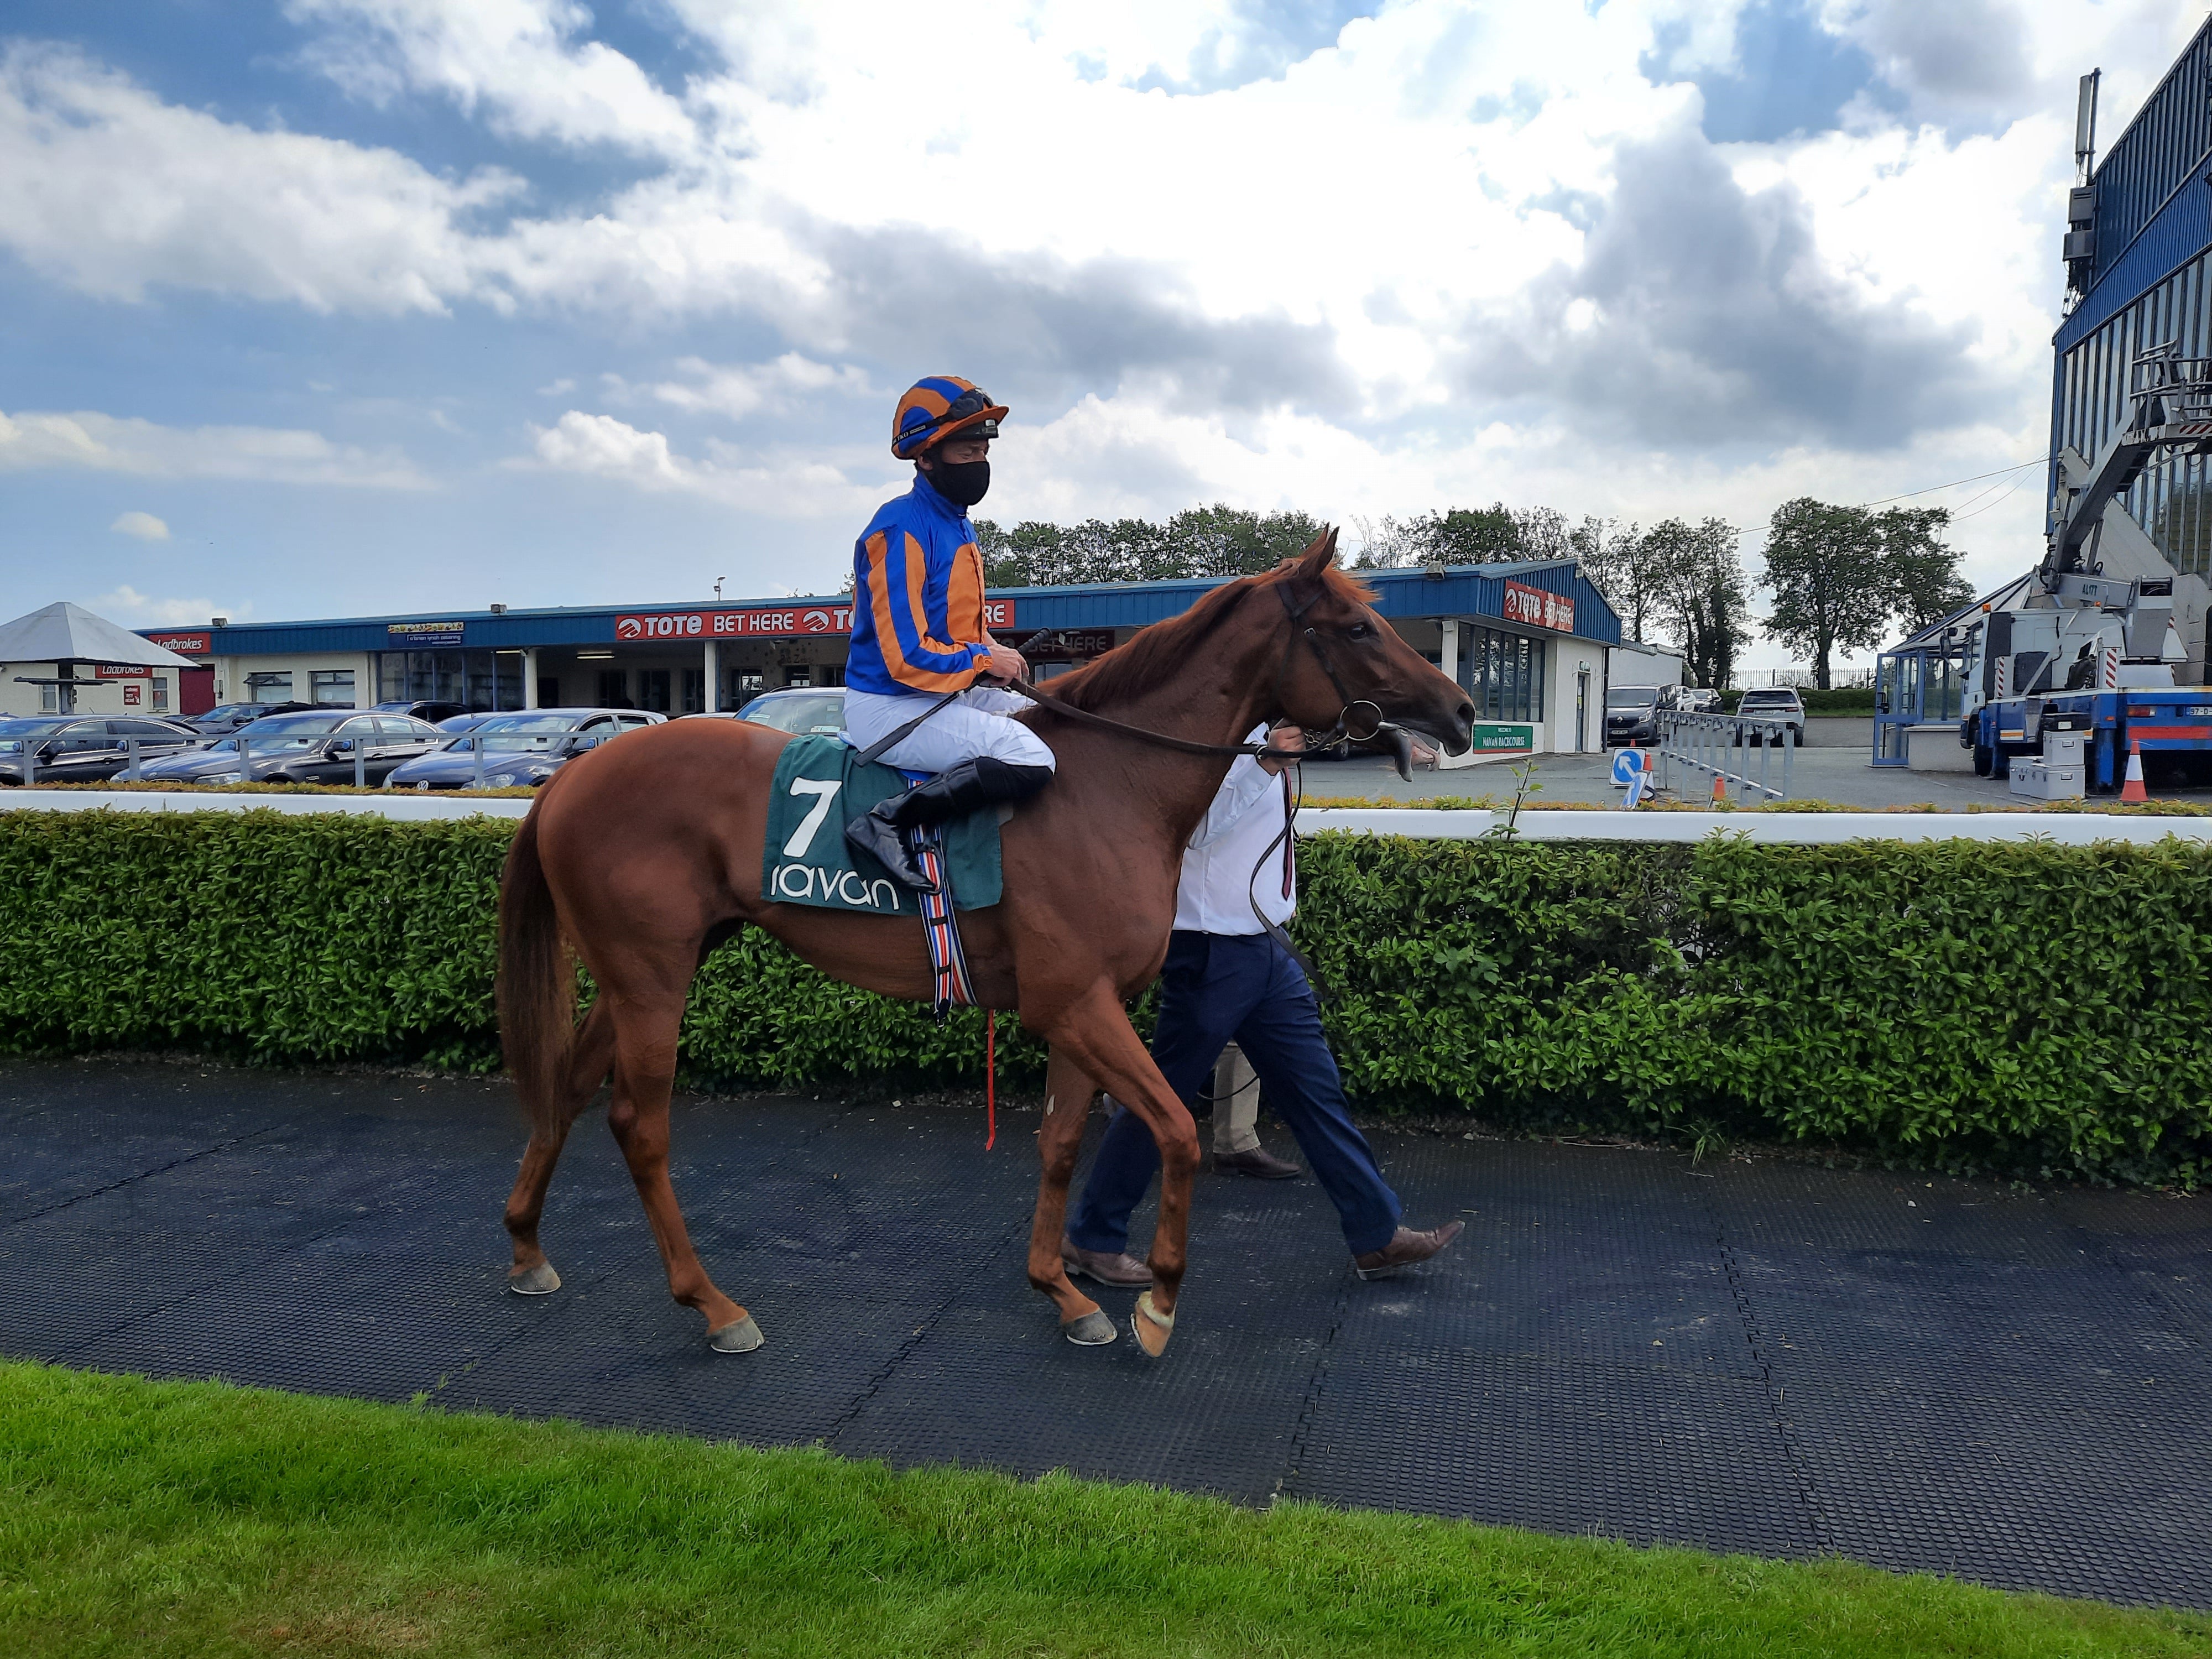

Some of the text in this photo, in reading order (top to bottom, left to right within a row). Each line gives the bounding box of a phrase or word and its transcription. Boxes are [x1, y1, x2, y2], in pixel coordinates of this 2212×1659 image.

[985, 604, 1005, 624] RE
[1545, 600, 1556, 620] BET
[1554, 603, 1572, 624] HERE
[714, 615, 745, 632] BET
[749, 613, 794, 631] HERE
[158, 638, 203, 650] Ladbrokes
[102, 666, 144, 674] Ladbrokes
[1483, 736, 1525, 747] NAVAN RACECOURSE
[783, 776, 843, 857] 7
